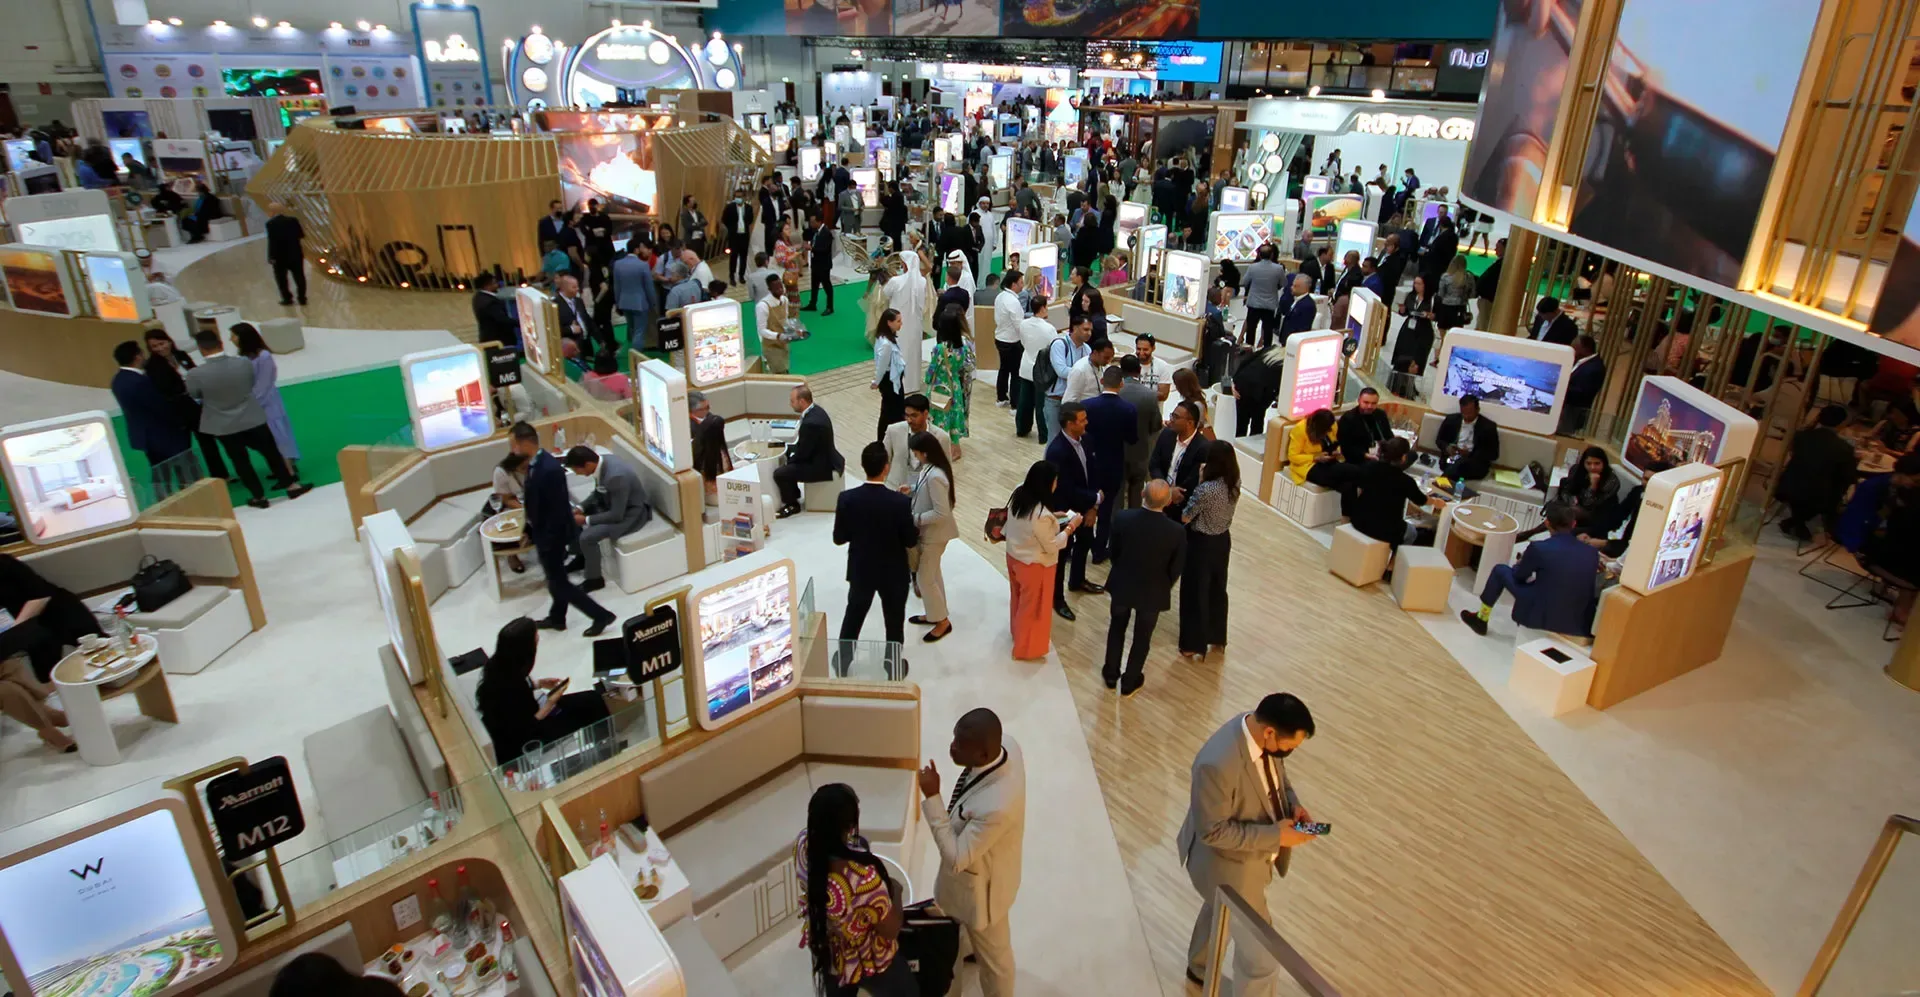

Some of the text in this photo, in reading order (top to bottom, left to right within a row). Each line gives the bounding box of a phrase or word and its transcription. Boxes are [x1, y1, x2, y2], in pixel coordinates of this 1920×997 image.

[1357, 112, 1440, 138] RUSTAR
[665, 339, 679, 350] M5
[1345, 342, 1356, 352] 46
[499, 372, 516, 384] M6
[632, 619, 674, 642] Marriott
[642, 651, 672, 676] M11
[219, 775, 284, 810] Marriott
[237, 815, 292, 850] M12
[69, 856, 104, 880] W
